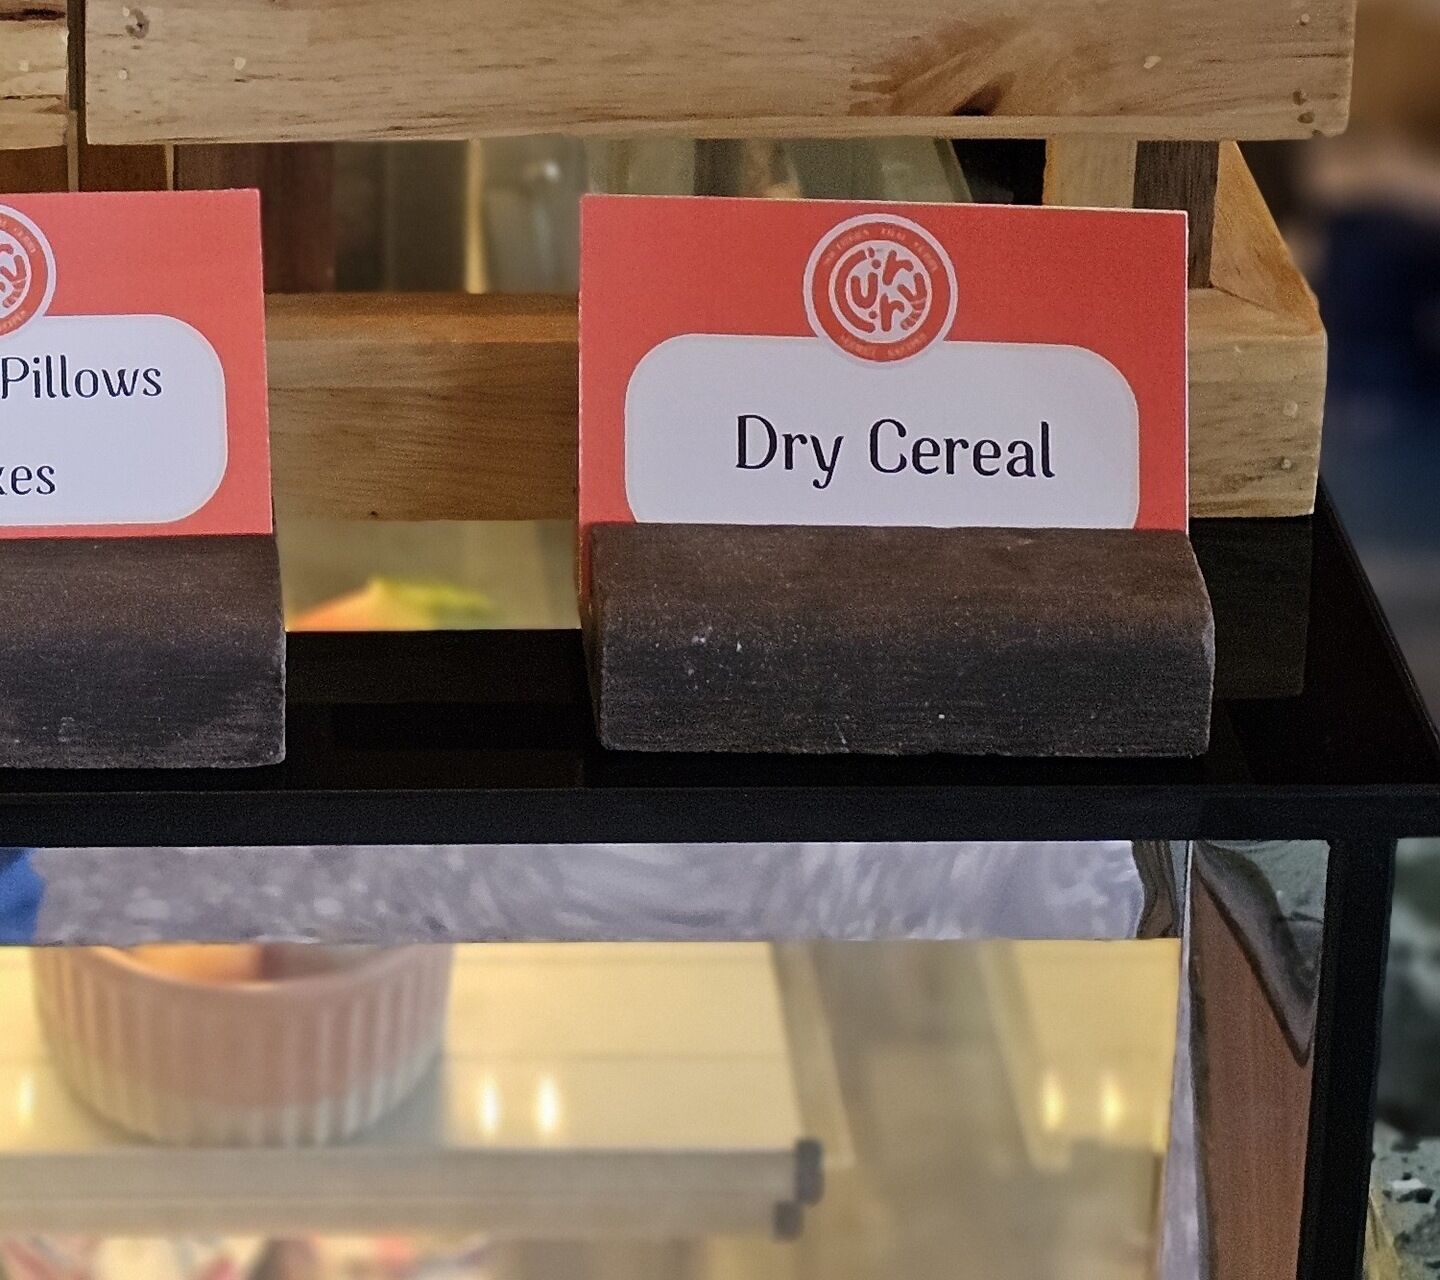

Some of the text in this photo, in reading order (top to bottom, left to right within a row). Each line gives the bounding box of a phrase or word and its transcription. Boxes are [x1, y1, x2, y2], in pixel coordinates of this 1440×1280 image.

[0, 354, 162, 400] Pillows
[735, 414, 1056, 490] Dry Cereal
